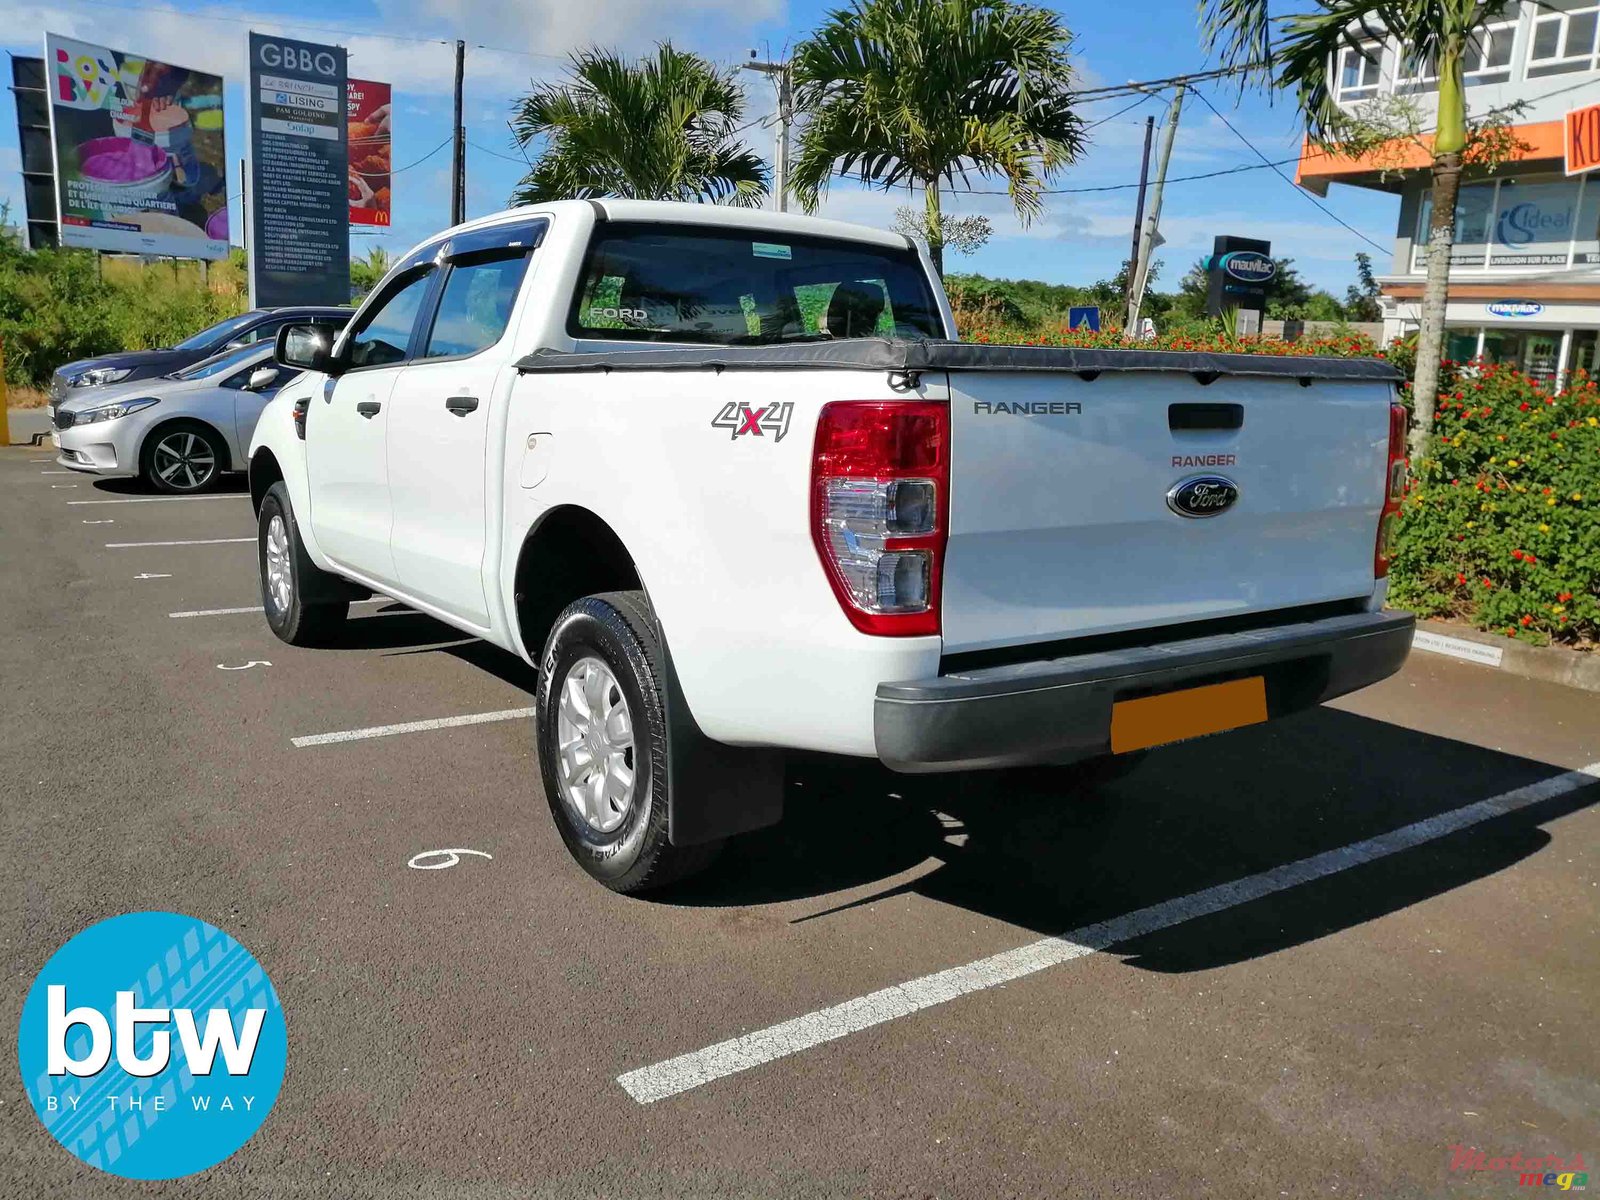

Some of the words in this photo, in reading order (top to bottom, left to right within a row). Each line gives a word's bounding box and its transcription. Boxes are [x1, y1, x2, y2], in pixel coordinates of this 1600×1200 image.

[260, 43, 336, 76] GBBQ
[288, 96, 325, 109] LISING
[275, 106, 291, 114] PAM
[292, 109, 325, 119] GOLDING
[133, 199, 177, 210] QUARTIERS
[1542, 255, 1567, 264] PLACE
[1230, 259, 1273, 274] mauvilac
[590, 307, 648, 320] FORD
[974, 401, 1082, 415] RANGER
[1172, 454, 1236, 467] RANGER
[1189, 483, 1229, 508] Ford
